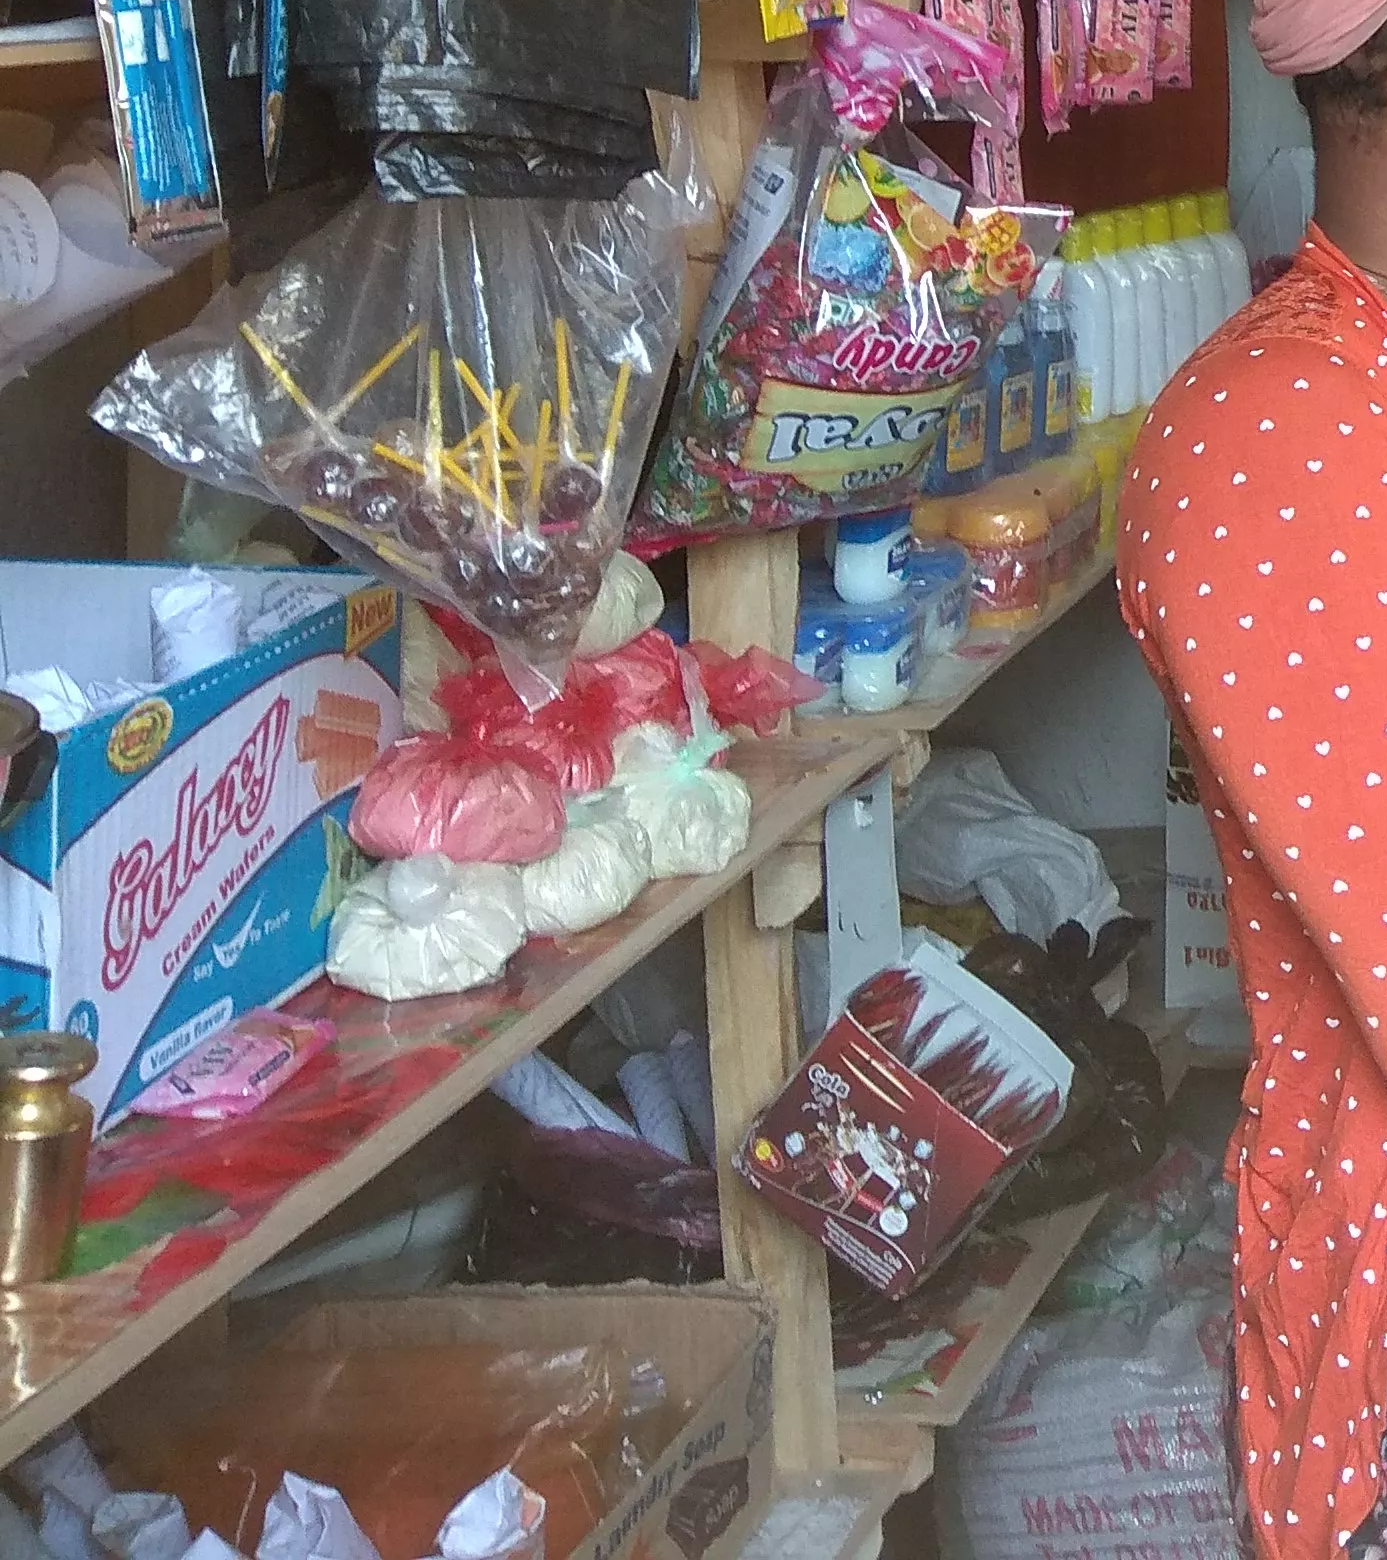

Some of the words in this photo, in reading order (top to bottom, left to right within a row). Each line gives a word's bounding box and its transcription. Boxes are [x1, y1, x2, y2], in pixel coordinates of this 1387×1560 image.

[767, 407, 952, 462] oyal
[350, 596, 394, 640] New
[161, 904, 217, 979] Cream
[218, 824, 276, 903] Wafers
[149, 1030, 192, 1070] Vanilla
